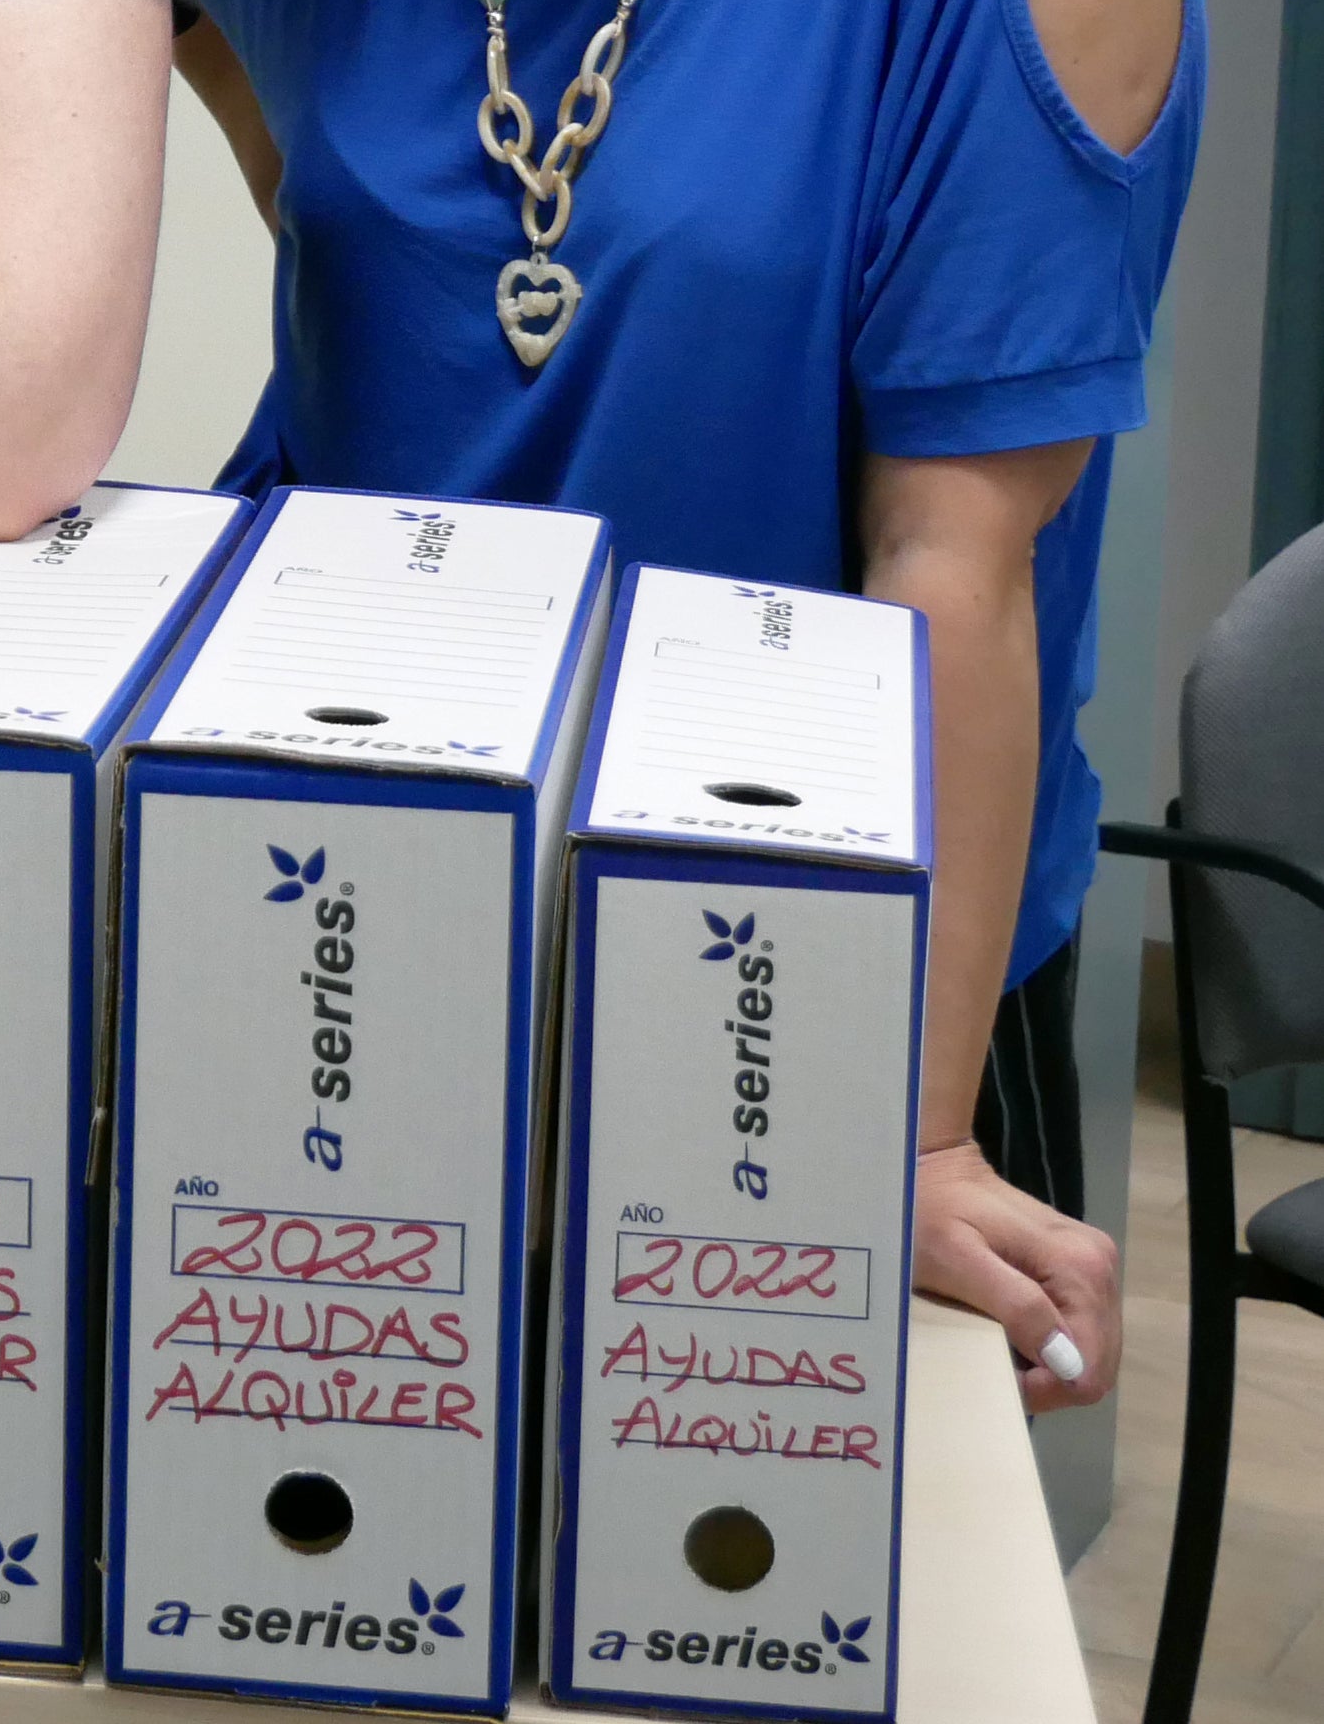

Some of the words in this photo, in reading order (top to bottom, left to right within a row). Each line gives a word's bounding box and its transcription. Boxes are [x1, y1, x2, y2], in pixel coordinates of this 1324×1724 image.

[174, 1176, 219, 1197] AÑO
[620, 1203, 664, 1224] AÑO
[181, 1211, 438, 1284] 2022
[612, 1238, 836, 1299] 2022
[153, 1287, 469, 1368] AYUDAS
[600, 1321, 866, 1394] AYUDAS
